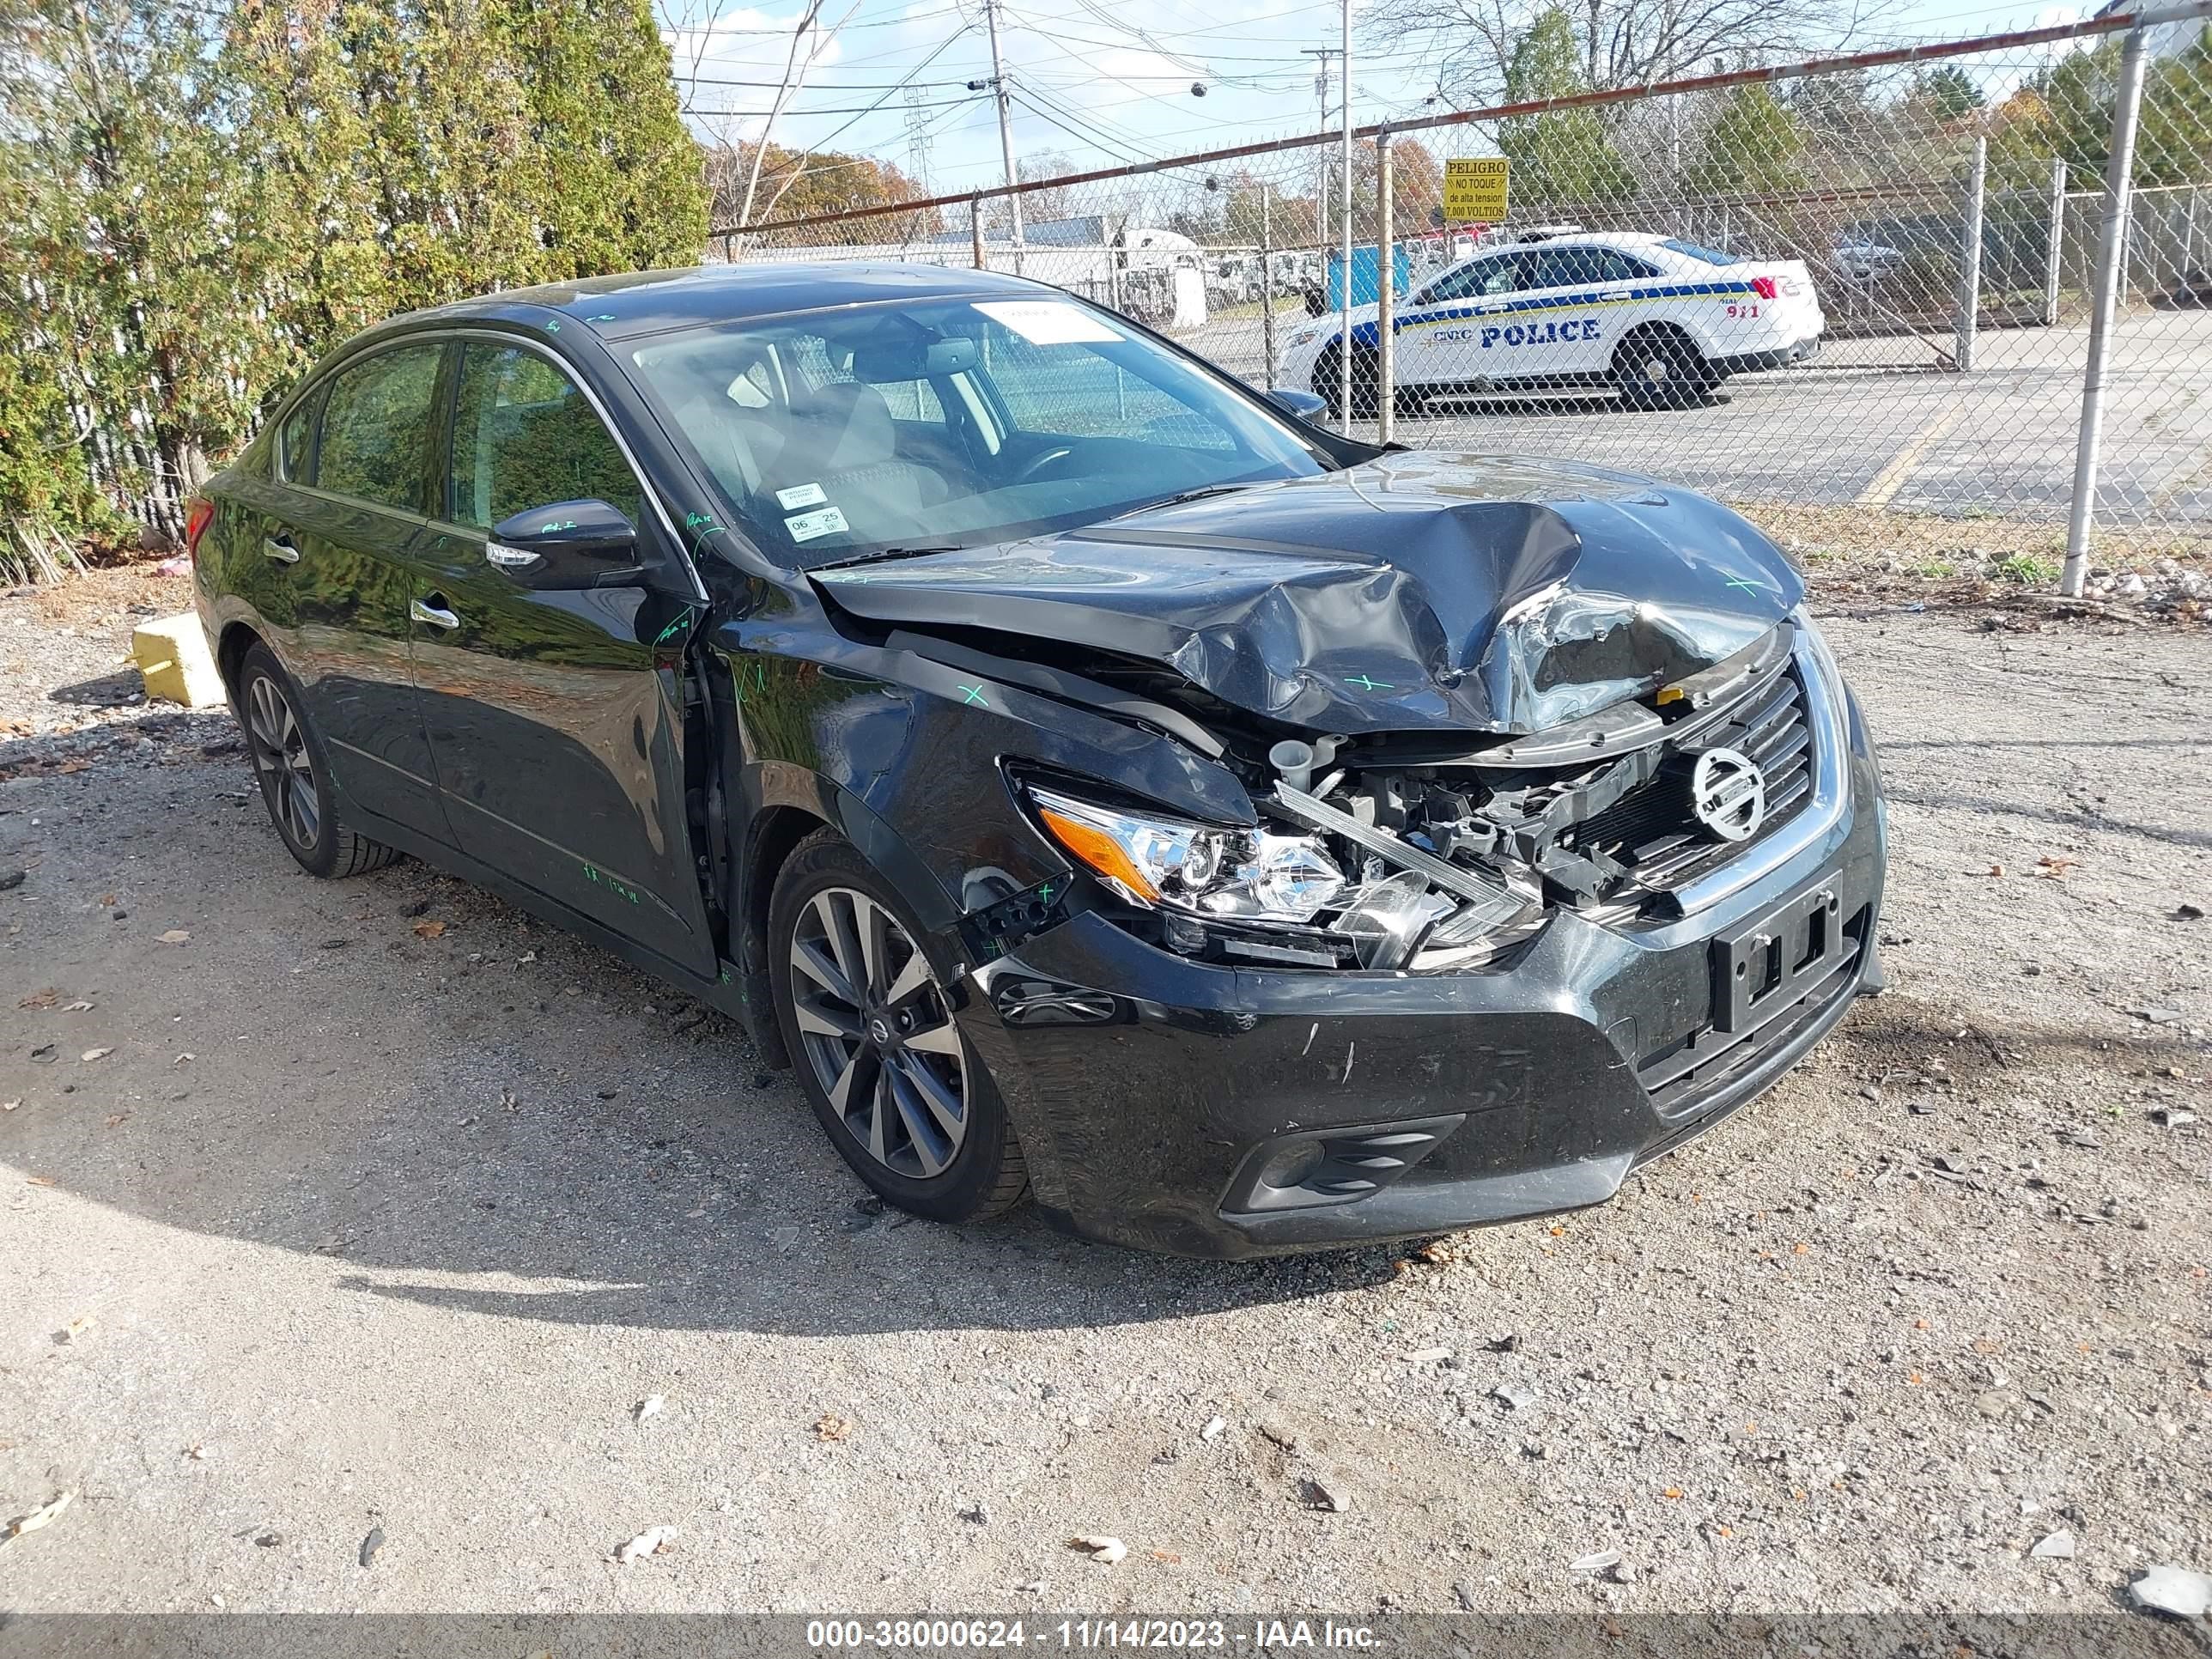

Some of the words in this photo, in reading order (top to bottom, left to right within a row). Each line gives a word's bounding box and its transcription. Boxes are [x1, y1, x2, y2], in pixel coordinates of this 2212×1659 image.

[1449, 161, 1505, 173] PELIGRO
[1456, 179, 1467, 189] NO
[1469, 179, 1496, 189] TOQUE
[1450, 193, 1459, 203] de
[1461, 193, 1473, 203] alta
[1475, 192, 1502, 203] tension
[1467, 206, 1504, 216] VOLTIOS
[1727, 306, 1759, 318] 911
[1481, 319, 1601, 349] POLICE
[792, 520, 808, 531] 06
[822, 513, 839, 522] 25
